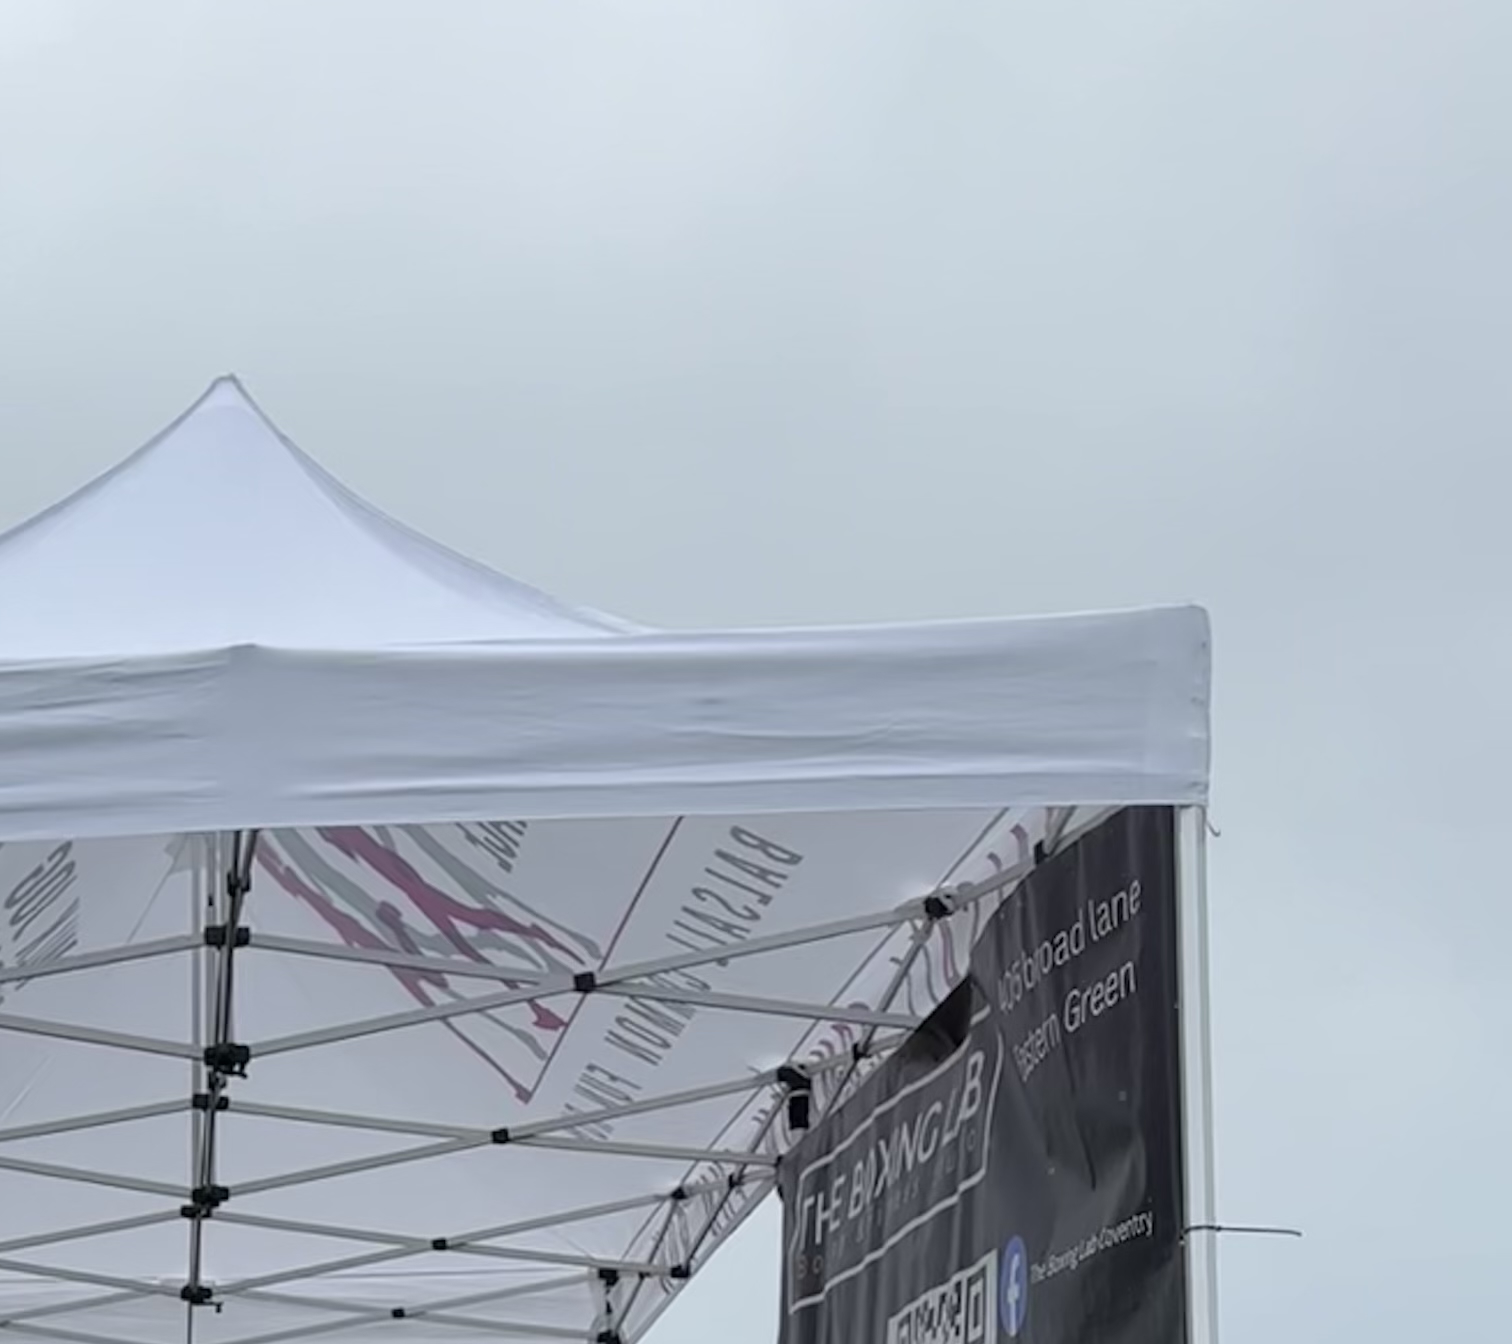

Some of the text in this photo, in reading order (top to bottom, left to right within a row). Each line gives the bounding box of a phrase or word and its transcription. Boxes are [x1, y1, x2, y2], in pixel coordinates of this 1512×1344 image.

[1021, 907, 1086, 990] broad
[1088, 878, 1142, 943] lane
[1063, 960, 1137, 1033] Green
[1098, 1210, 1154, 1251] Coventry
